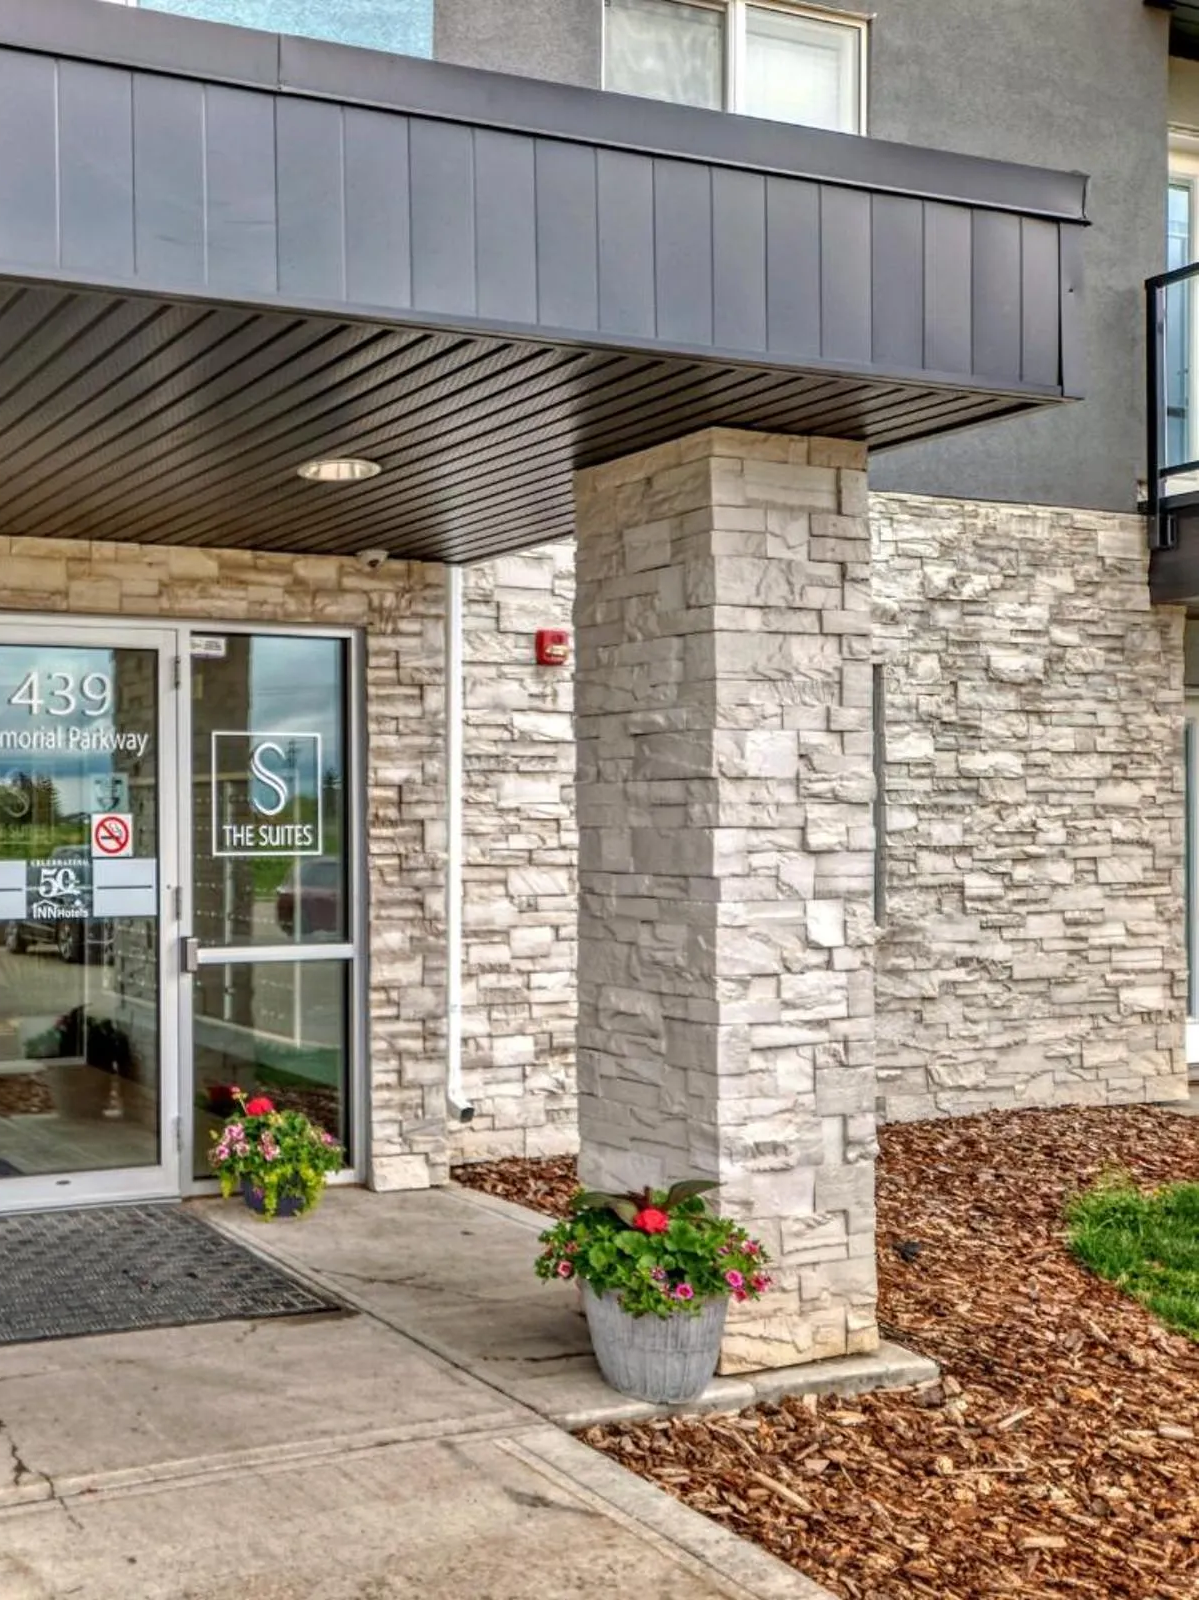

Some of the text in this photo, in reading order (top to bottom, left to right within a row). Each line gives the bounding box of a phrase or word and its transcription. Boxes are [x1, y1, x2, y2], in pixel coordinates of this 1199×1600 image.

[9, 671, 113, 716] 439
[69, 727, 148, 756] Parkway
[222, 825, 313, 846] THE SUITES
[40, 868, 81, 898] 50
